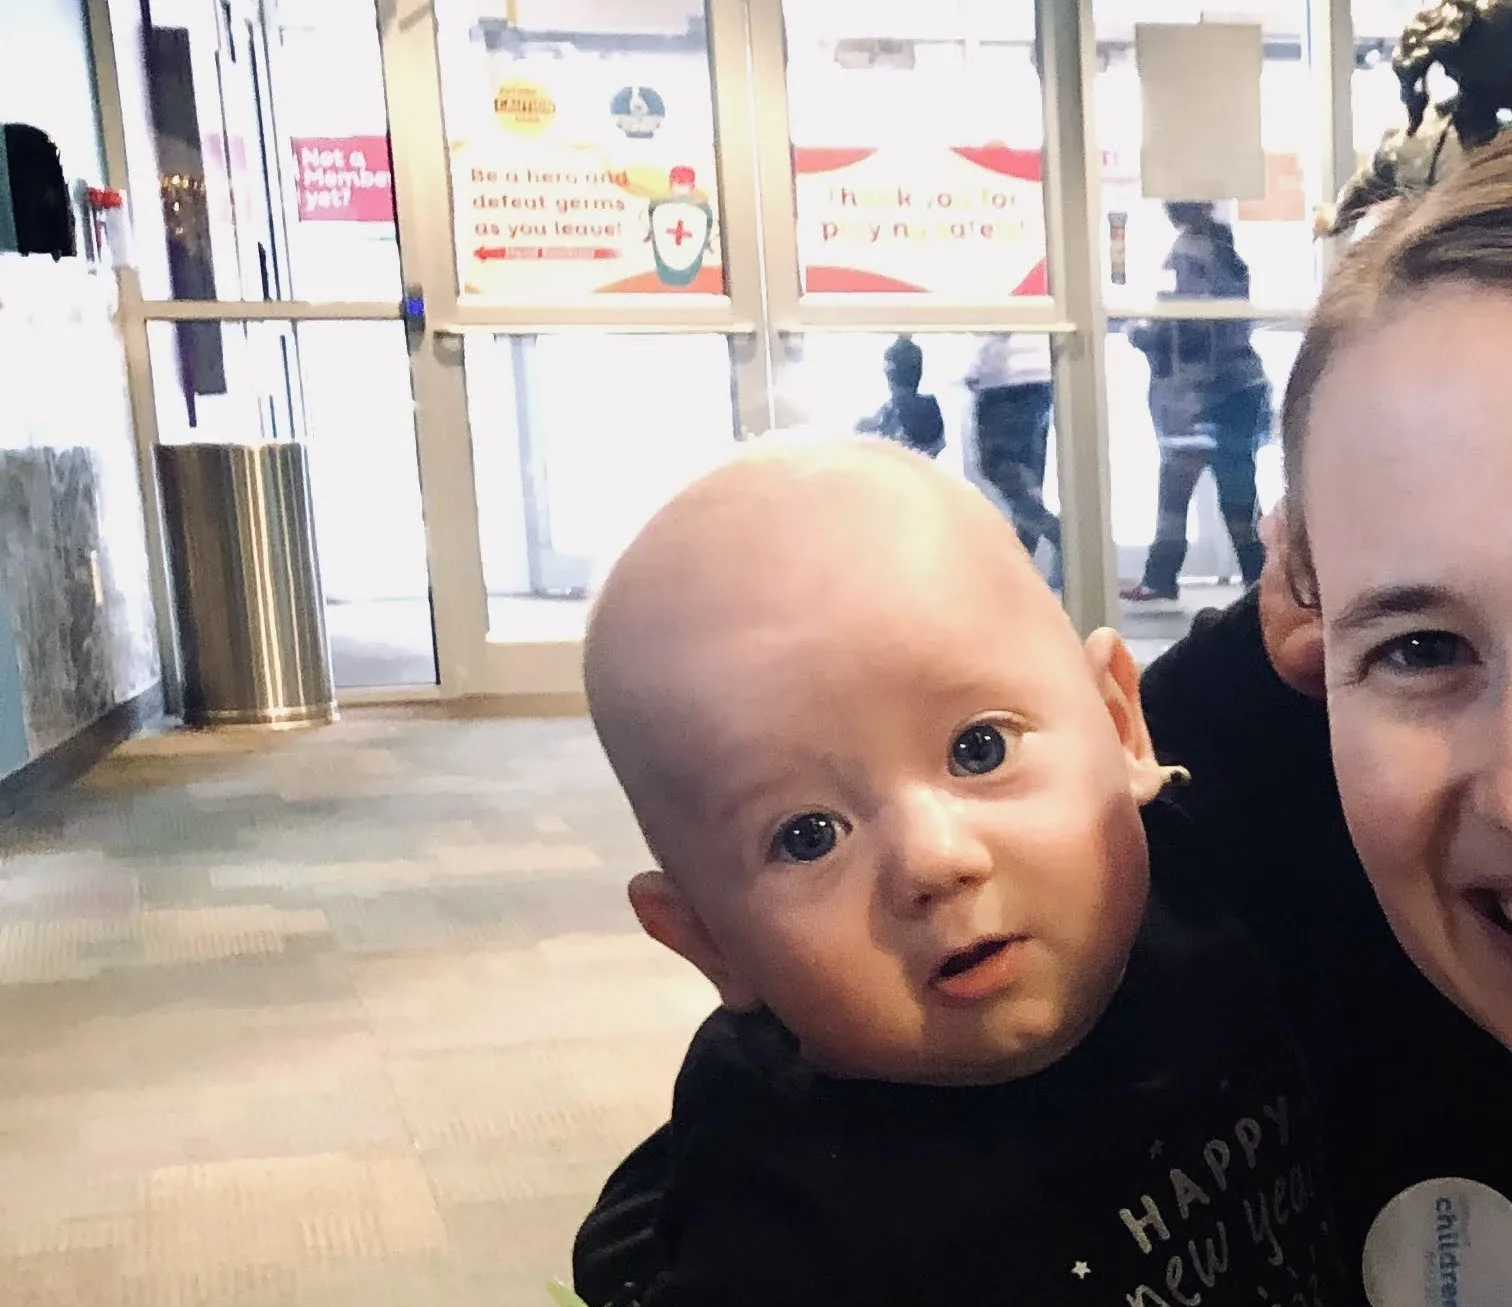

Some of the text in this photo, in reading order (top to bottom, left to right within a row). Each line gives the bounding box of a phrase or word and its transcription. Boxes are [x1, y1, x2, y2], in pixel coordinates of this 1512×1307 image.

[301, 147, 345, 169] Not
[304, 166, 392, 188] Membe
[471, 168, 498, 183] Be
[473, 195, 625, 216] defeat germs
[475, 224, 500, 236] as
[508, 223, 547, 239] you
[1119, 1096, 1291, 1254] HAPPY
